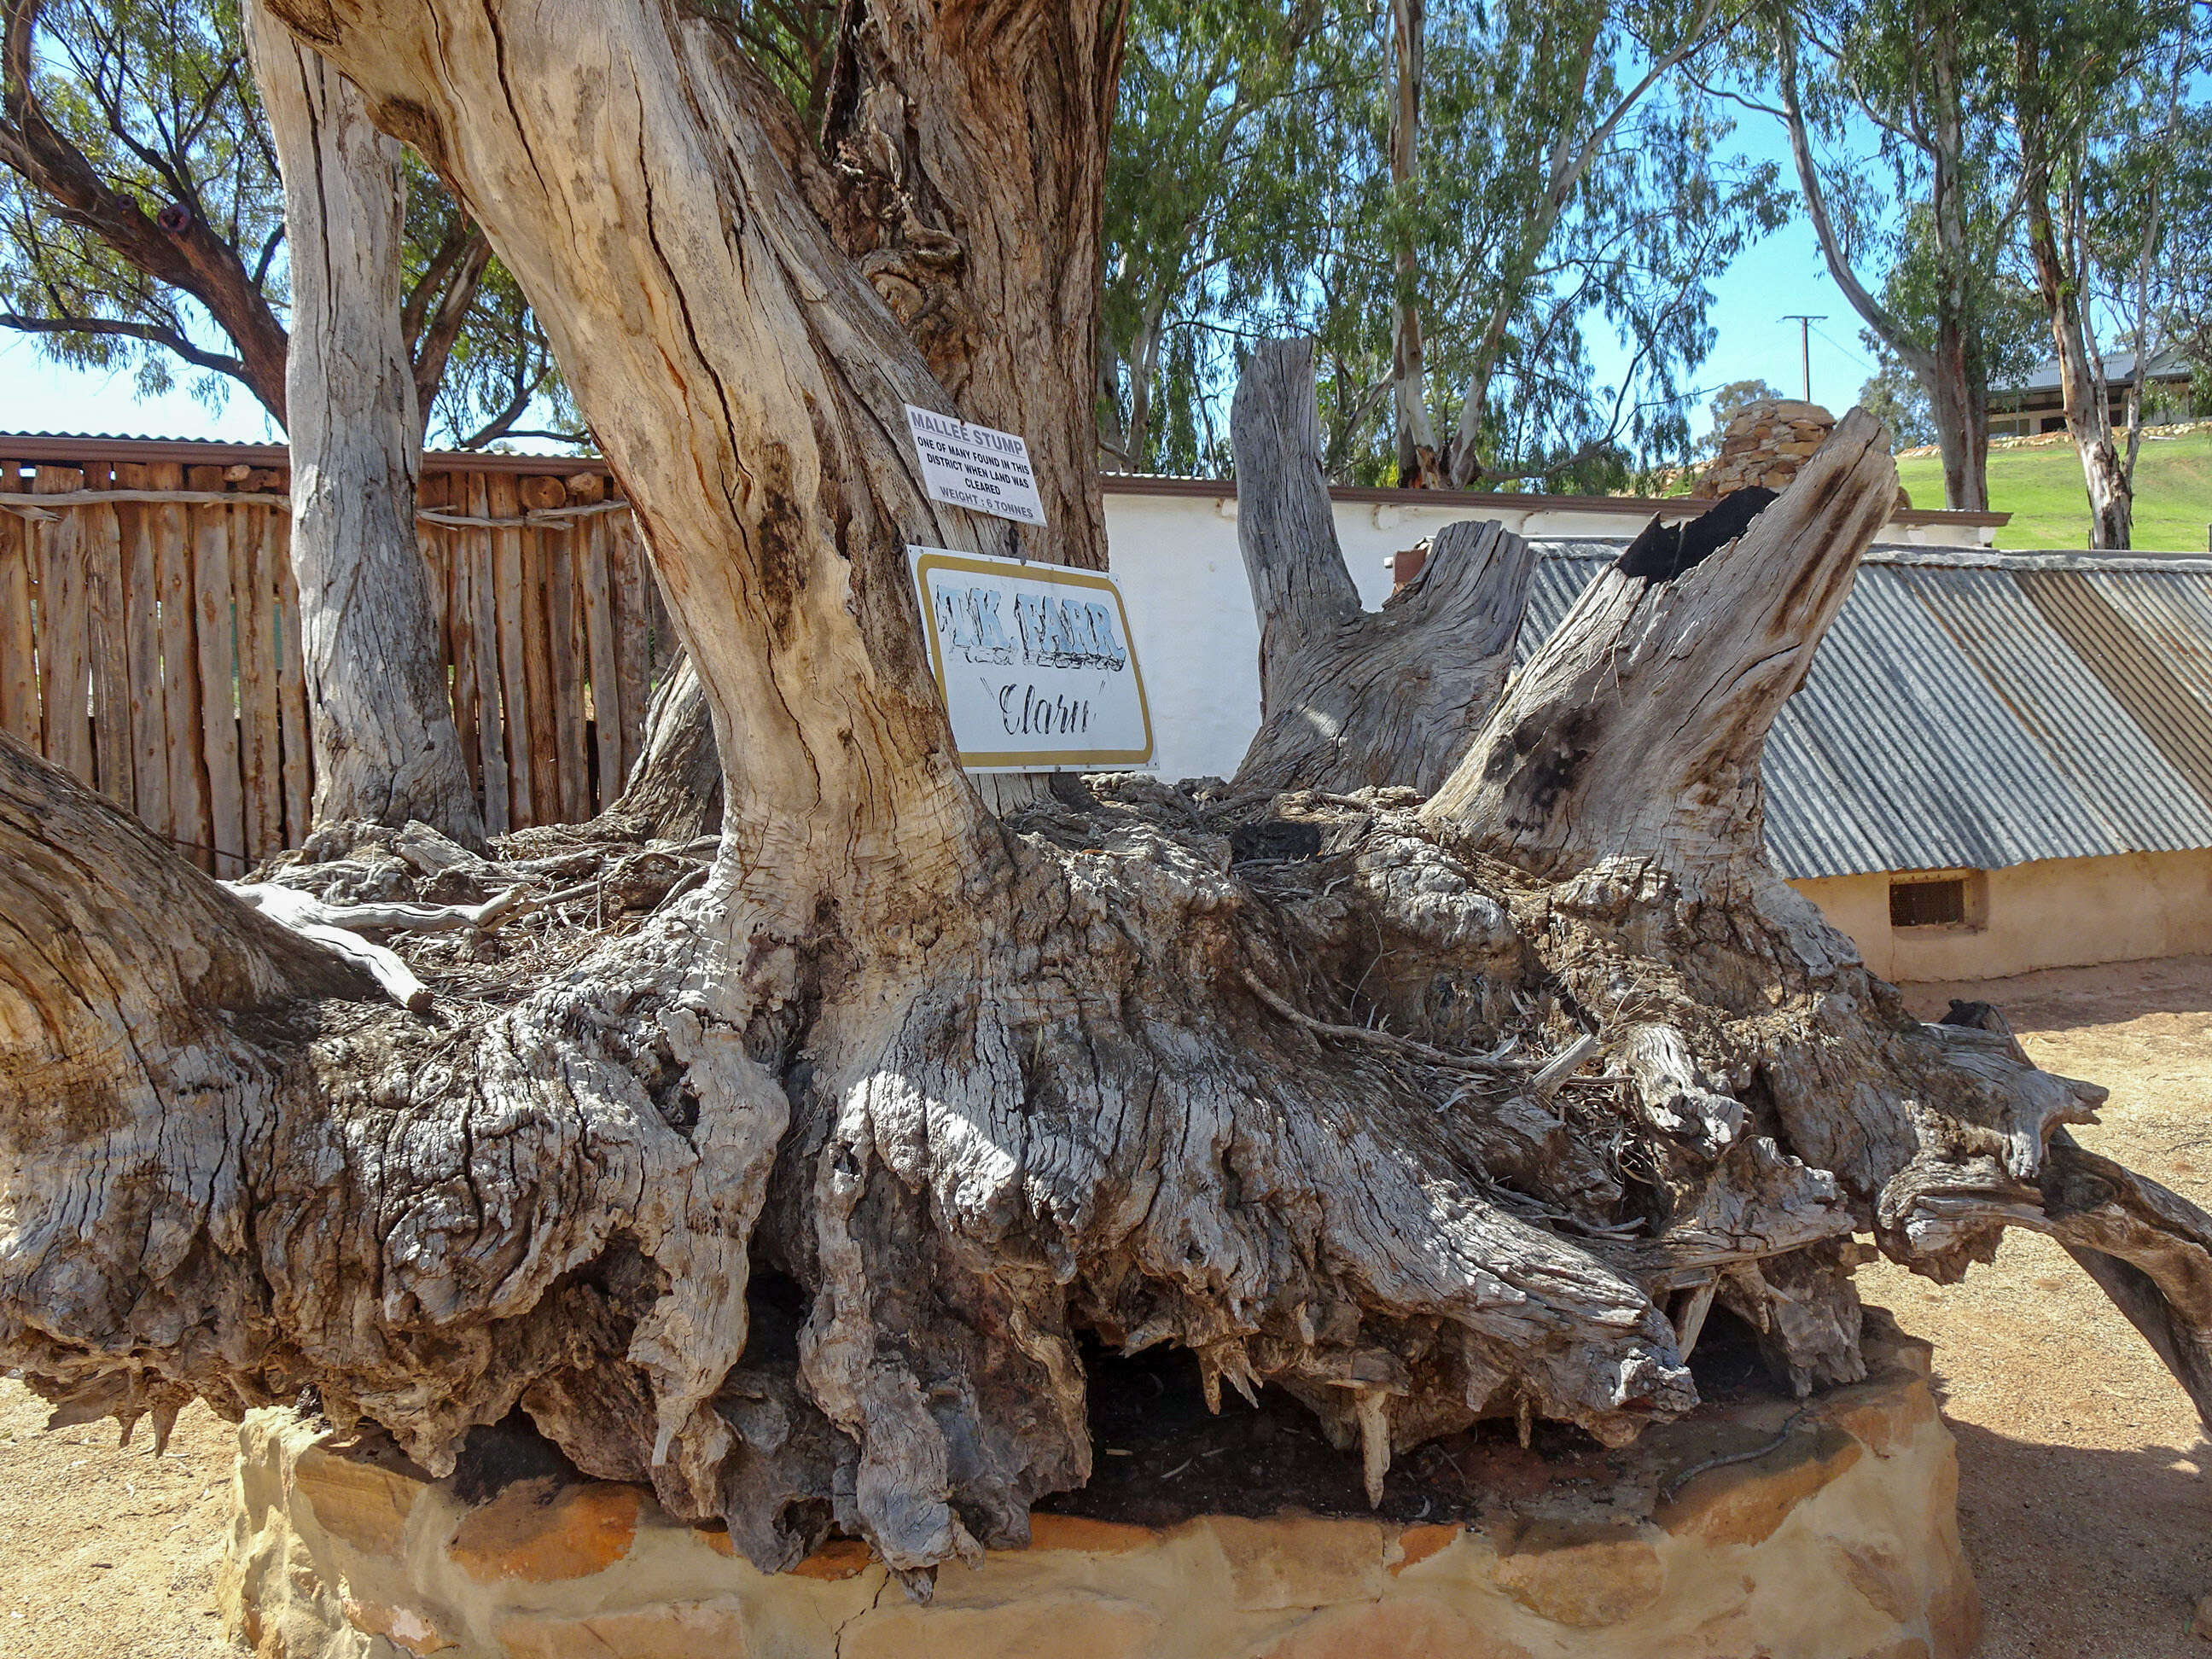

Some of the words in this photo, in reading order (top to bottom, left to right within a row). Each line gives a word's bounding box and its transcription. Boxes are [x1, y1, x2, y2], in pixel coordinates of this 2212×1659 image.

[911, 411, 970, 442] MALLEE
[973, 429, 1023, 455] STUMP
[917, 436, 935, 451] ONE
[937, 441, 946, 452] OF
[948, 445, 971, 460] MANY
[973, 452, 999, 468] FOUND
[1002, 459, 1010, 469] IN
[1011, 463, 1030, 475] THIS
[927, 453, 963, 472] DISTRICT
[964, 463, 988, 479] WHEN
[990, 470, 1010, 484] LAND
[1012, 476, 1029, 489] WAS
[940, 486, 978, 504] WEIGHT
[987, 498, 993, 509] 6
[994, 500, 1033, 518] TONNES
[965, 478, 1001, 496] CLEARED
